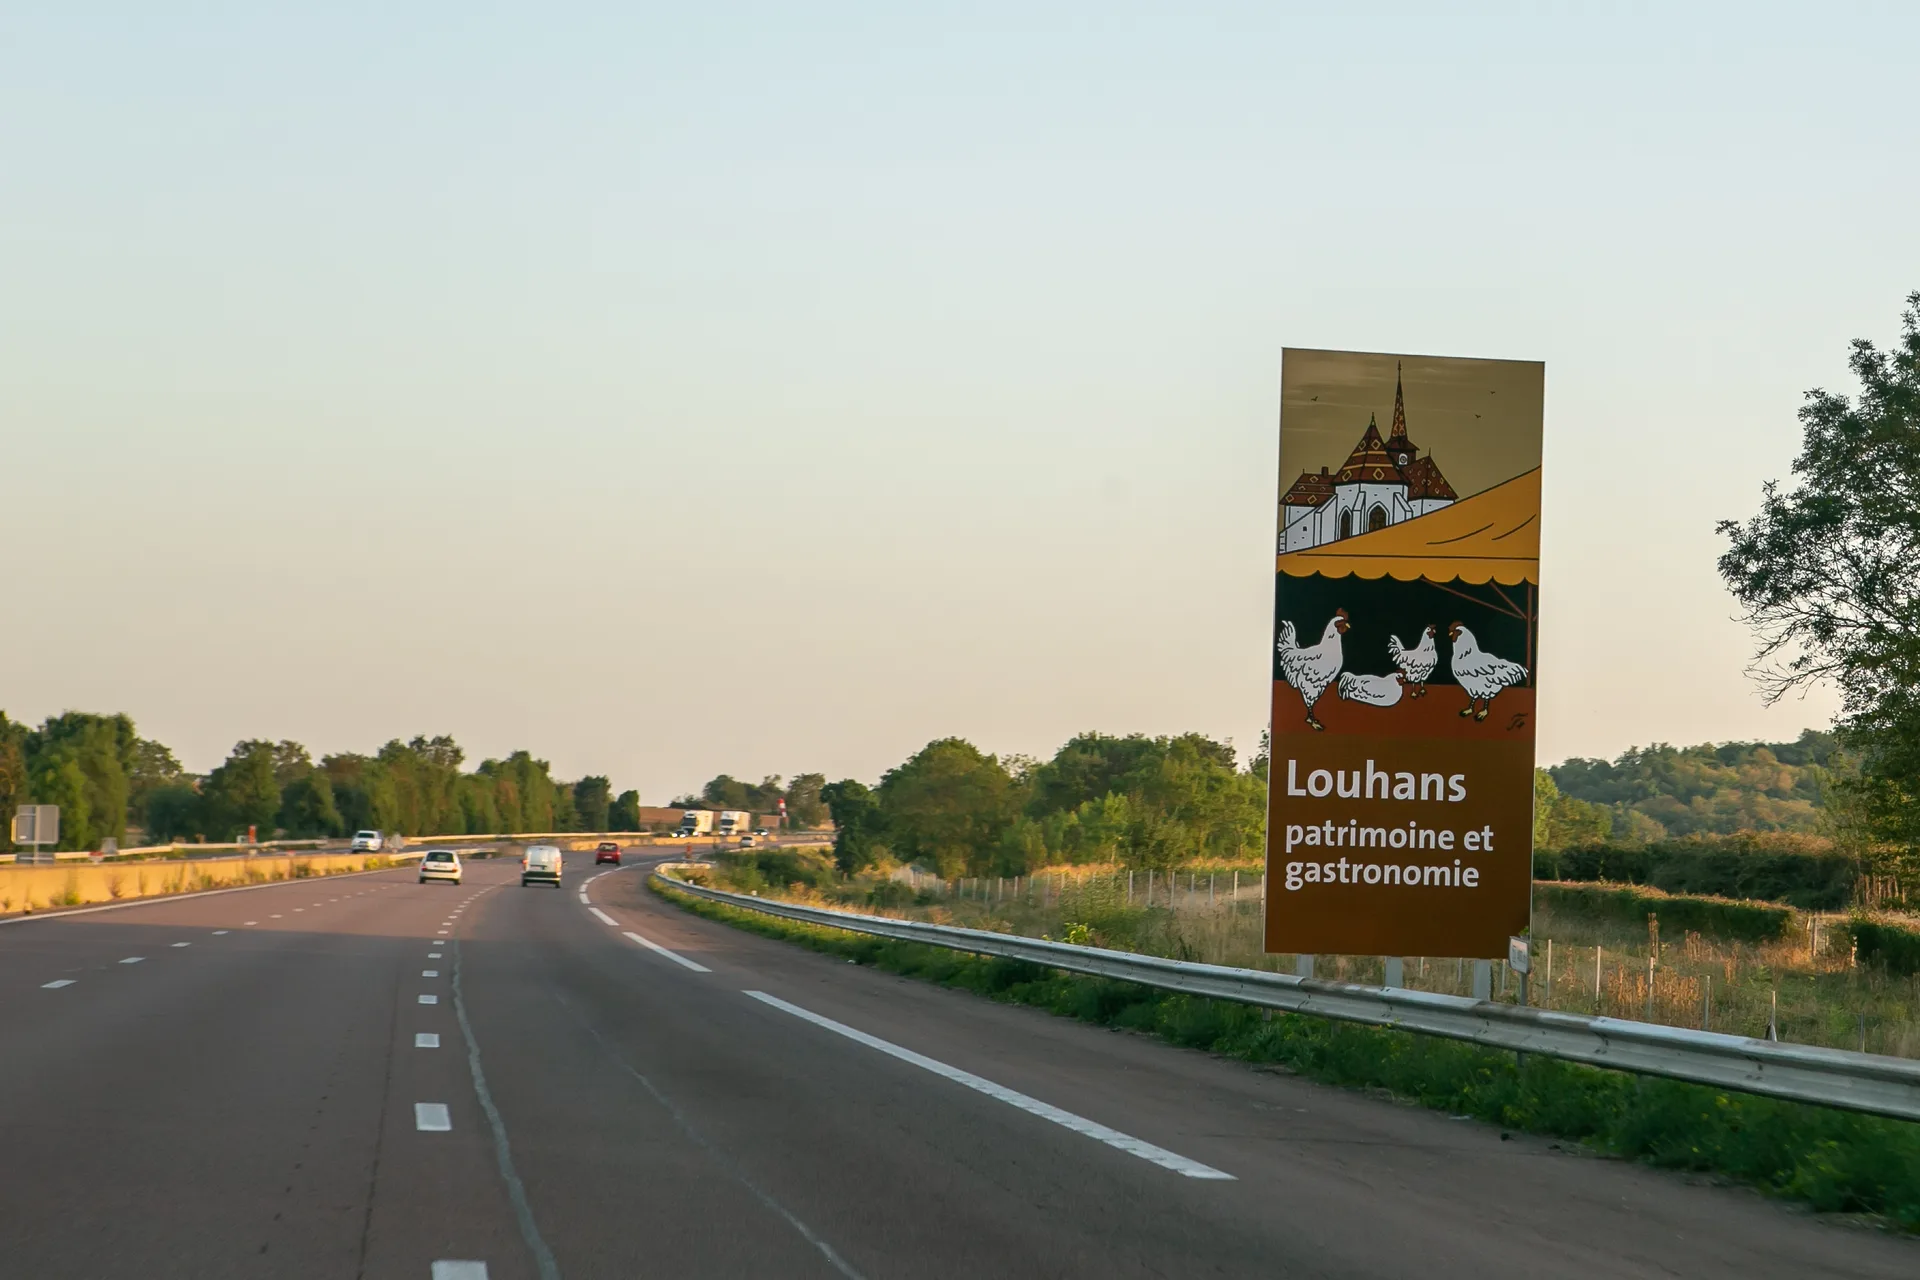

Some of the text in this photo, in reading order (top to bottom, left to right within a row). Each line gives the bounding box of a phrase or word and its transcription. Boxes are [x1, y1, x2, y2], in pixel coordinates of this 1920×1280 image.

[1287, 759, 1467, 802] Louhans
[1285, 818, 1494, 854] patrimoine et
[1284, 856, 1480, 891] gastronomie
